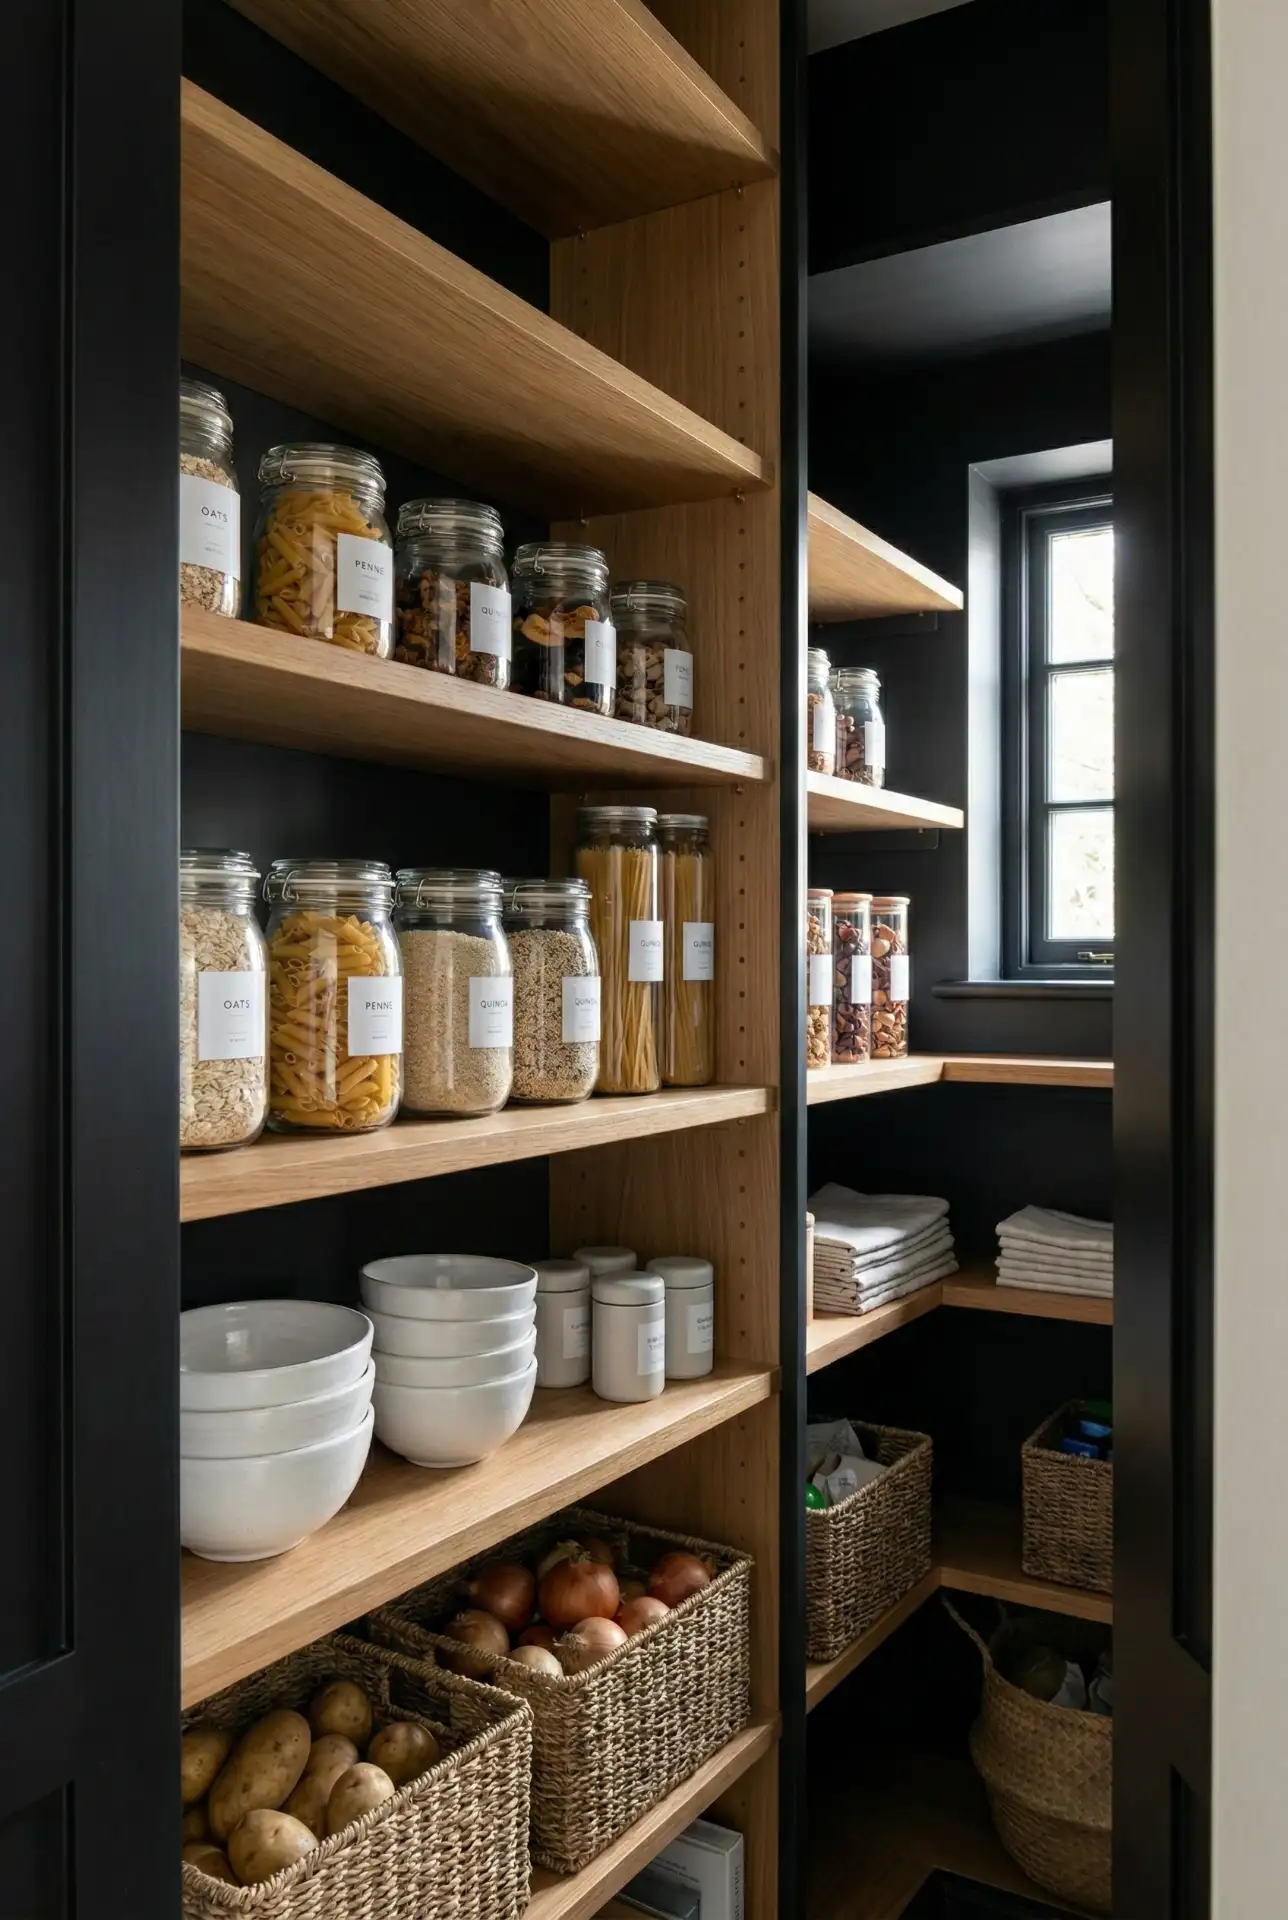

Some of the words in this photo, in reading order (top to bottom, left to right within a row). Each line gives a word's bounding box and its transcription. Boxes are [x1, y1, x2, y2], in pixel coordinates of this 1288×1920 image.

[201, 506, 228, 523] OATS
[355, 560, 385, 576] PENNE
[223, 1000, 250, 1010] OATS
[365, 1001, 393, 1010] PENNE
